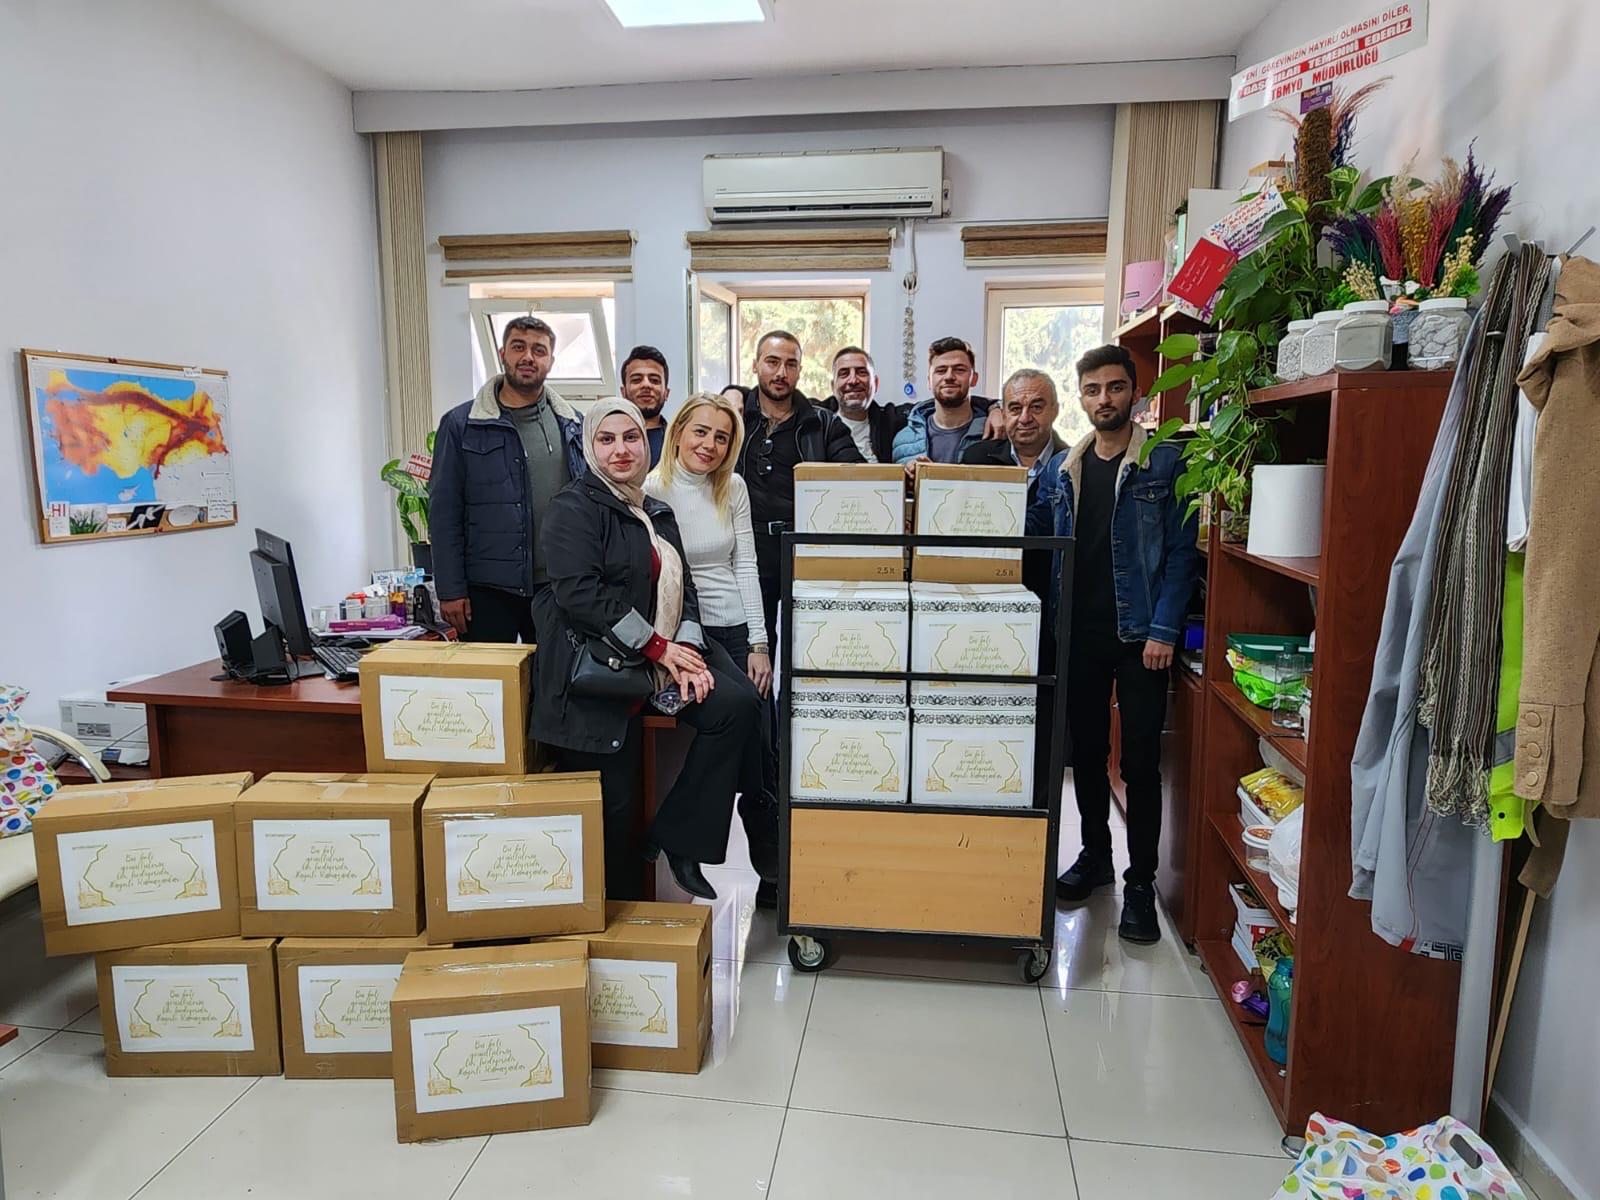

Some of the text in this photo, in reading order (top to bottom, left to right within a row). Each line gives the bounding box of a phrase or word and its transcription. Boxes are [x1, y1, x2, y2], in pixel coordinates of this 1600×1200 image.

[1341, 16, 1379, 39] OLMASINI
[1365, 20, 1409, 46] EDERİZ
[1312, 46, 1379, 84] MÜDÜRLÜĞÜ
